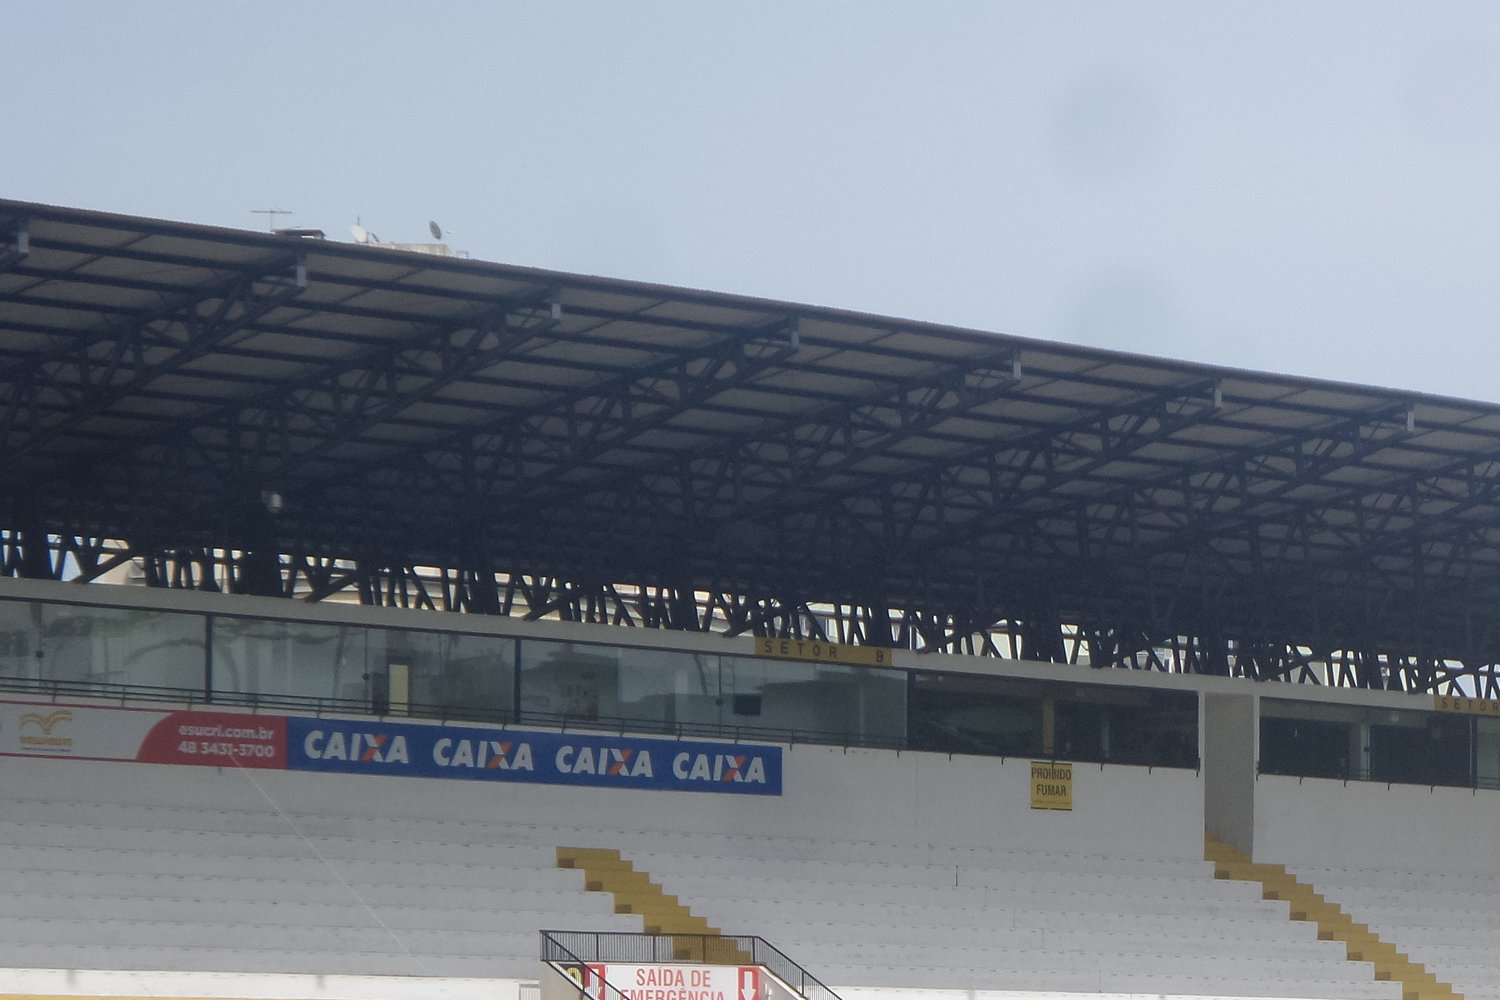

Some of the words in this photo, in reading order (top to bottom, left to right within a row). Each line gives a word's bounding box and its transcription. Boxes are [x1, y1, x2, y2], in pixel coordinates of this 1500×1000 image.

[764, 640, 838, 659] SETOR
[875, 650, 884, 663] B
[1441, 697, 1499, 712] SETOR
[178, 724, 274, 740] esucri.com.br
[304, 730, 410, 765] CAIXA
[433, 738, 534, 771] CAIXA
[556, 746, 653, 778] CAIXA
[672, 752, 766, 784] CAIXA
[1031, 767, 1071, 780] PROIBIDO
[1036, 784, 1067, 797] FUMAR
[636, 966, 684, 987] SAÍDA
[691, 969, 711, 987] DE
